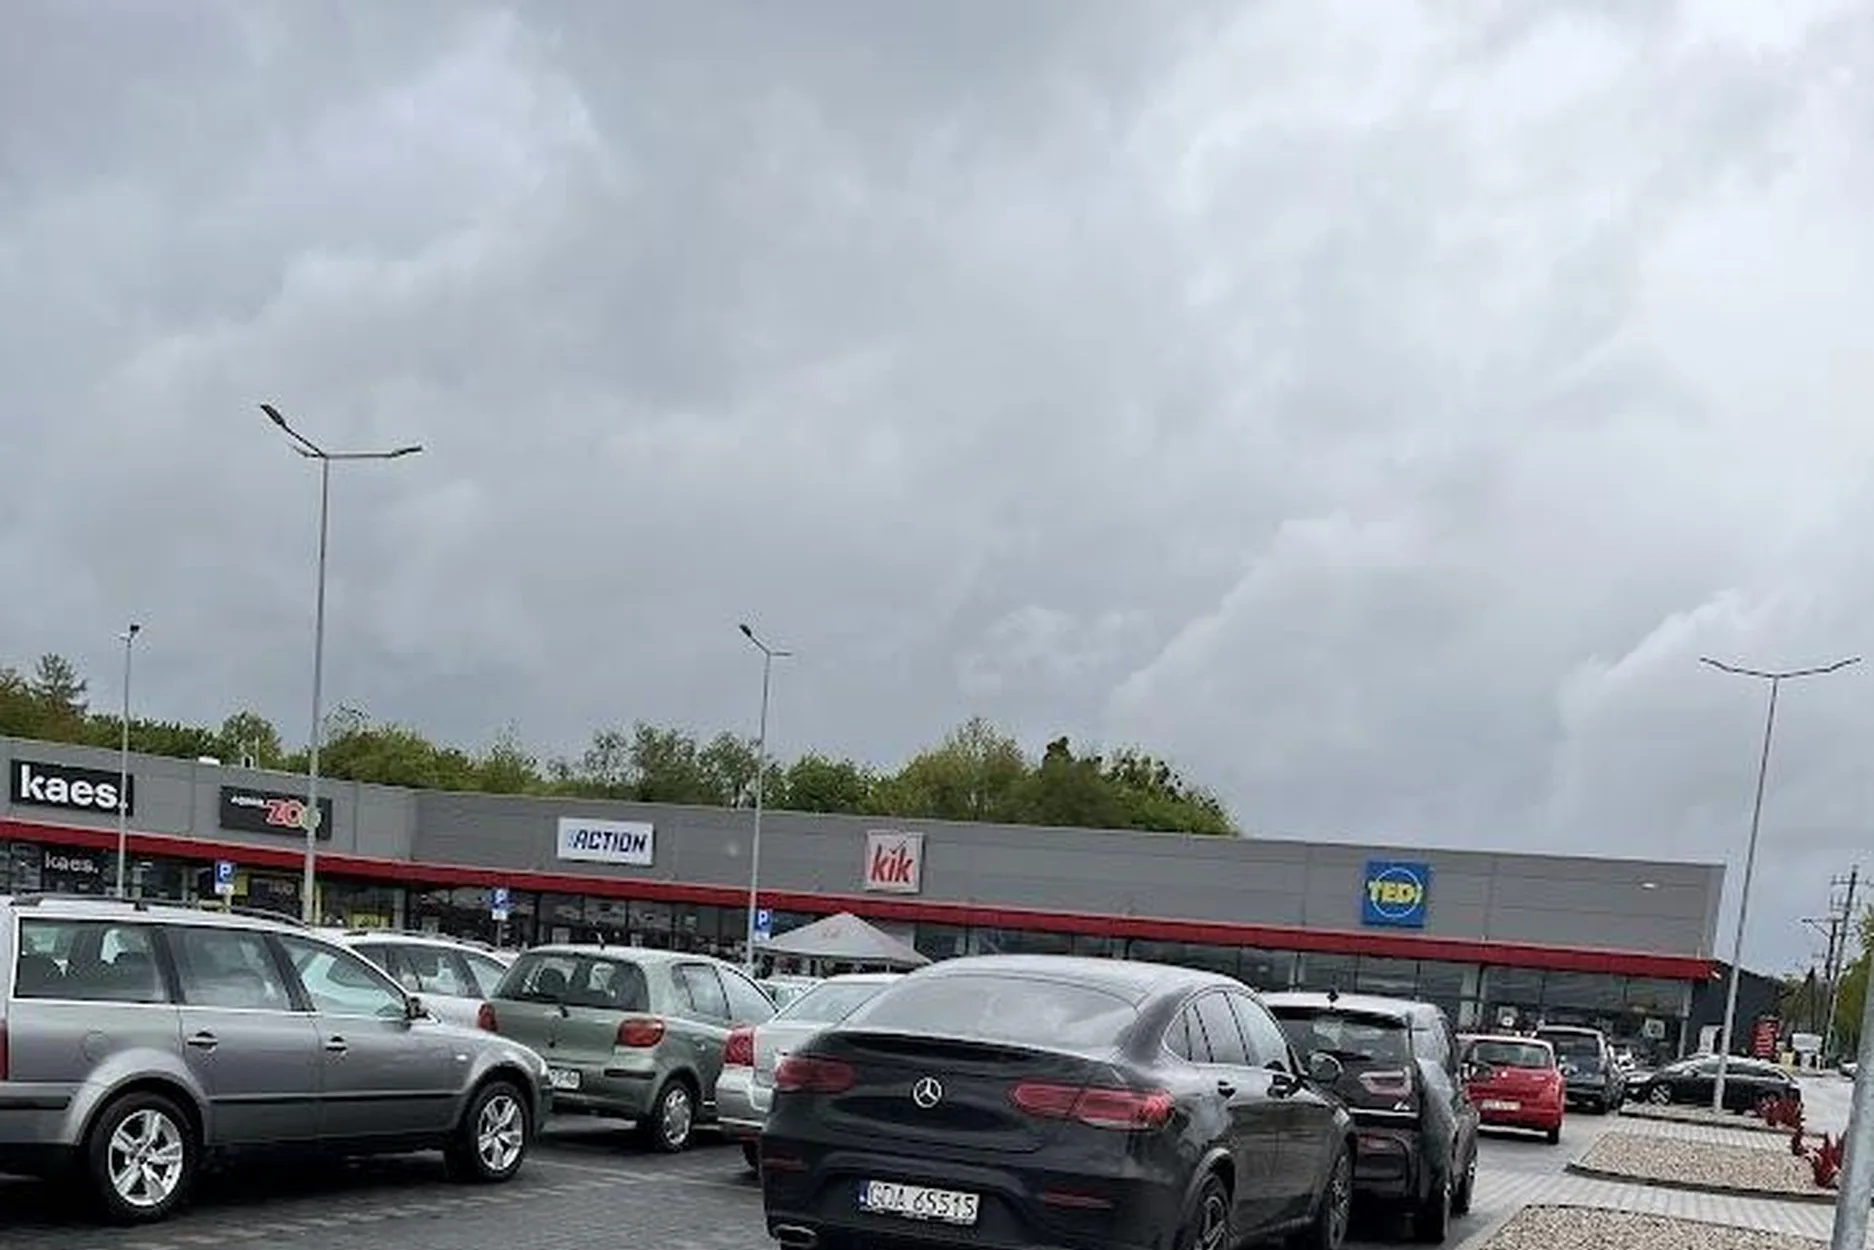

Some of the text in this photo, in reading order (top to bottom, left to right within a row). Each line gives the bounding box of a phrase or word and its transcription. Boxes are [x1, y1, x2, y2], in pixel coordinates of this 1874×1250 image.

[573, 829, 648, 852] ACTION
[220, 864, 232, 880] P
[758, 909, 769, 926] P
